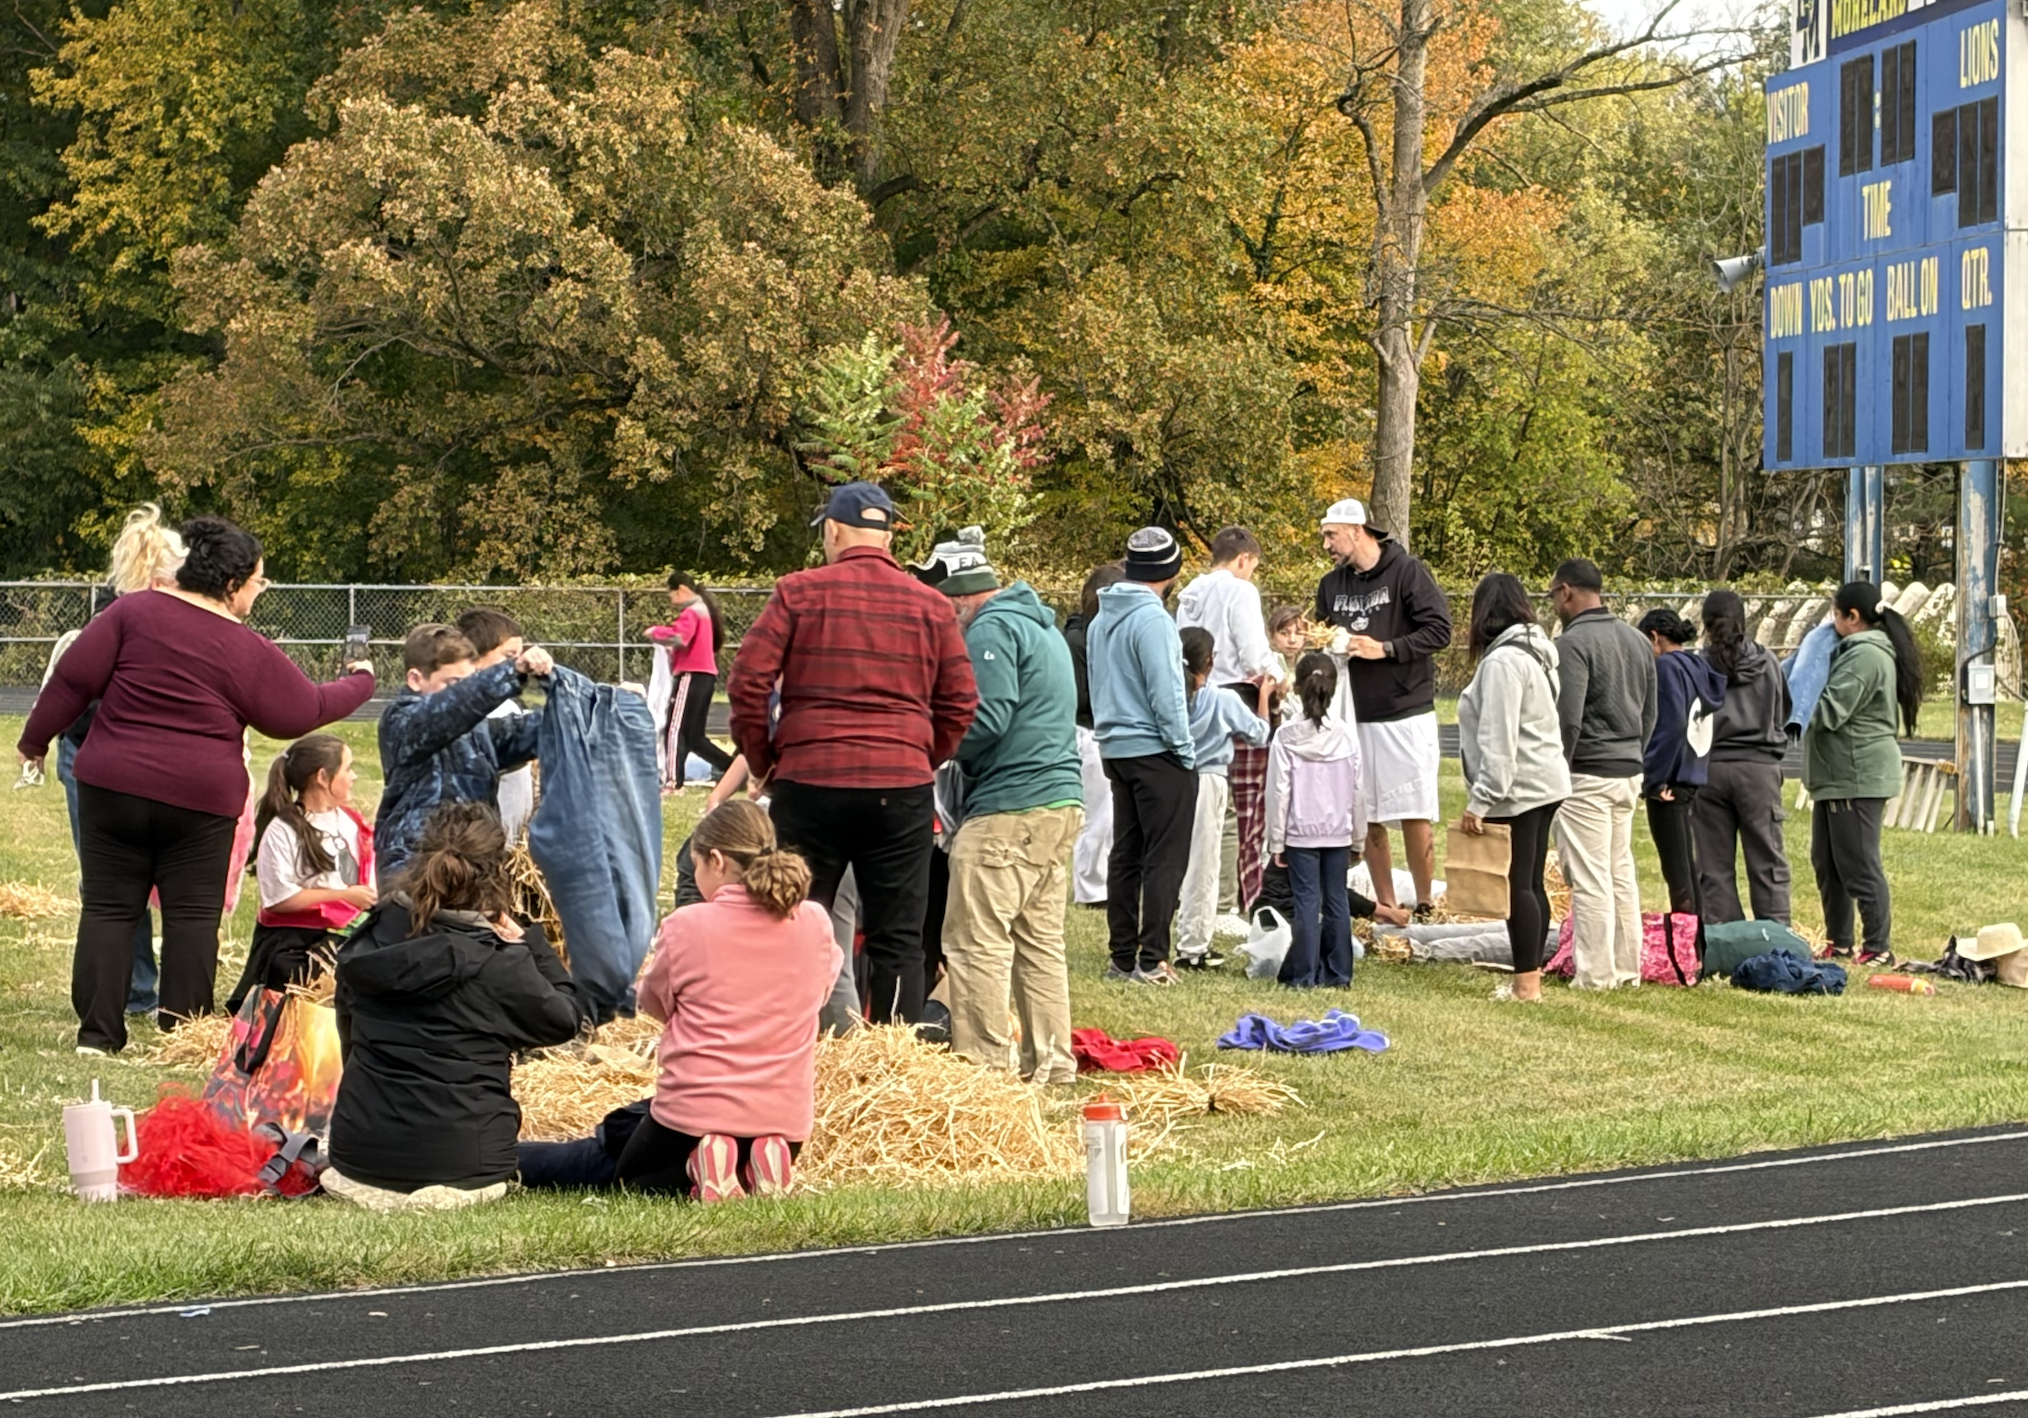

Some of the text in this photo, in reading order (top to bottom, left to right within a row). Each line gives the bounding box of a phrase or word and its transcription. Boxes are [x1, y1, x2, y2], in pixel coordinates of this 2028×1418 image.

[1960, 18, 1999, 88] LIONS
[1767, 82, 1809, 144] VISITOR
[1862, 180, 1892, 240] TIME
[1809, 268, 1874, 333] YDS. TO GO
[1886, 256, 1939, 321] BALL ON
[1962, 247, 1992, 310] QTR.
[1770, 282, 1803, 339] DOWN
